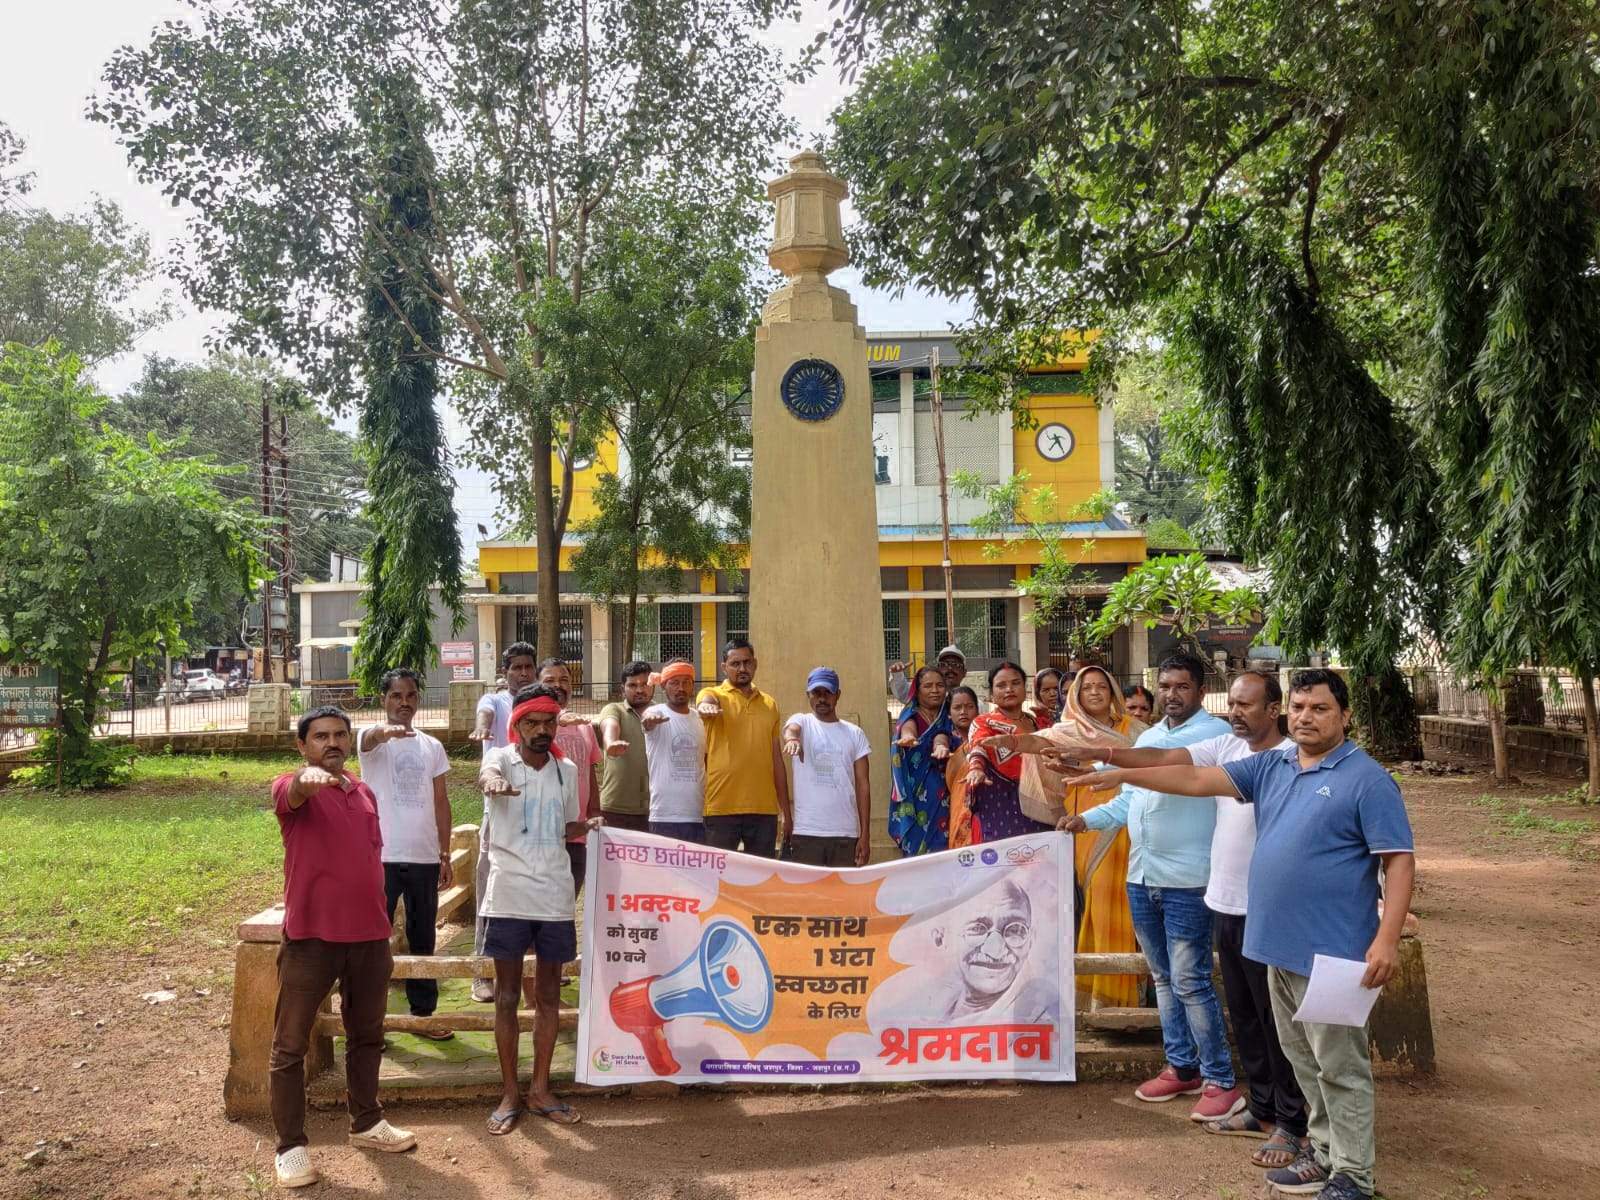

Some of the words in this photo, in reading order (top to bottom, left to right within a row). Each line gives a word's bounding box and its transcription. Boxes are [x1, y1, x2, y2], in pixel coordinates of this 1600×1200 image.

[604, 842, 649, 864] स्वच्छ
[655, 844, 728, 874] छत्तीसगढ़
[607, 894, 615, 912] 1
[621, 894, 701, 922] अक्टूबर
[607, 923, 625, 939] को
[628, 926, 658, 944] सुबह
[752, 915, 802, 938] एक
[807, 916, 868, 938] साथ
[606, 951, 621, 963] 10
[624, 948, 647, 964] बजे
[814, 950, 823, 967] 1
[830, 941, 875, 967] घंटा
[774, 975, 869, 995] स्वच्छता
[807, 1002, 826, 1020] के
[828, 1001, 861, 1019] लिए
[878, 1024, 1054, 1066] श्रमदान
